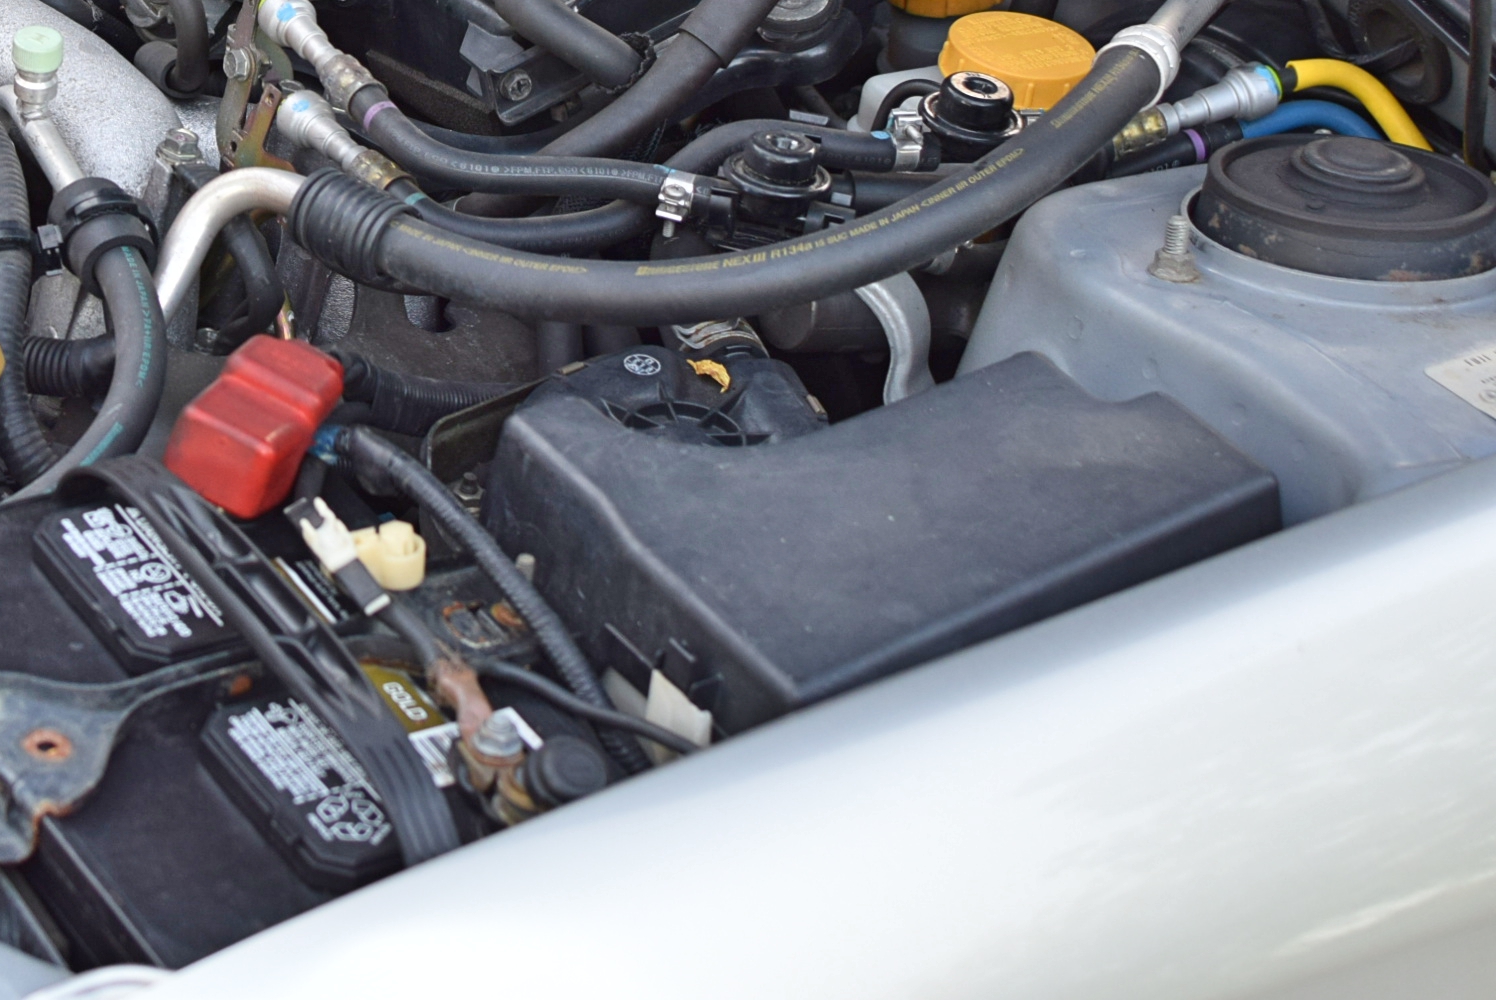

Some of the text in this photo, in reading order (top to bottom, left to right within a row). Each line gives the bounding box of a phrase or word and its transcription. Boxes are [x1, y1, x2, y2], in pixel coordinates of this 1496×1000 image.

[847, 220, 878, 238] MADE
[877, 215, 890, 227] IN
[888, 201, 921, 223] JAPAN
[967, 162, 997, 185] OUTER
[381, 680, 429, 723] GOLD
